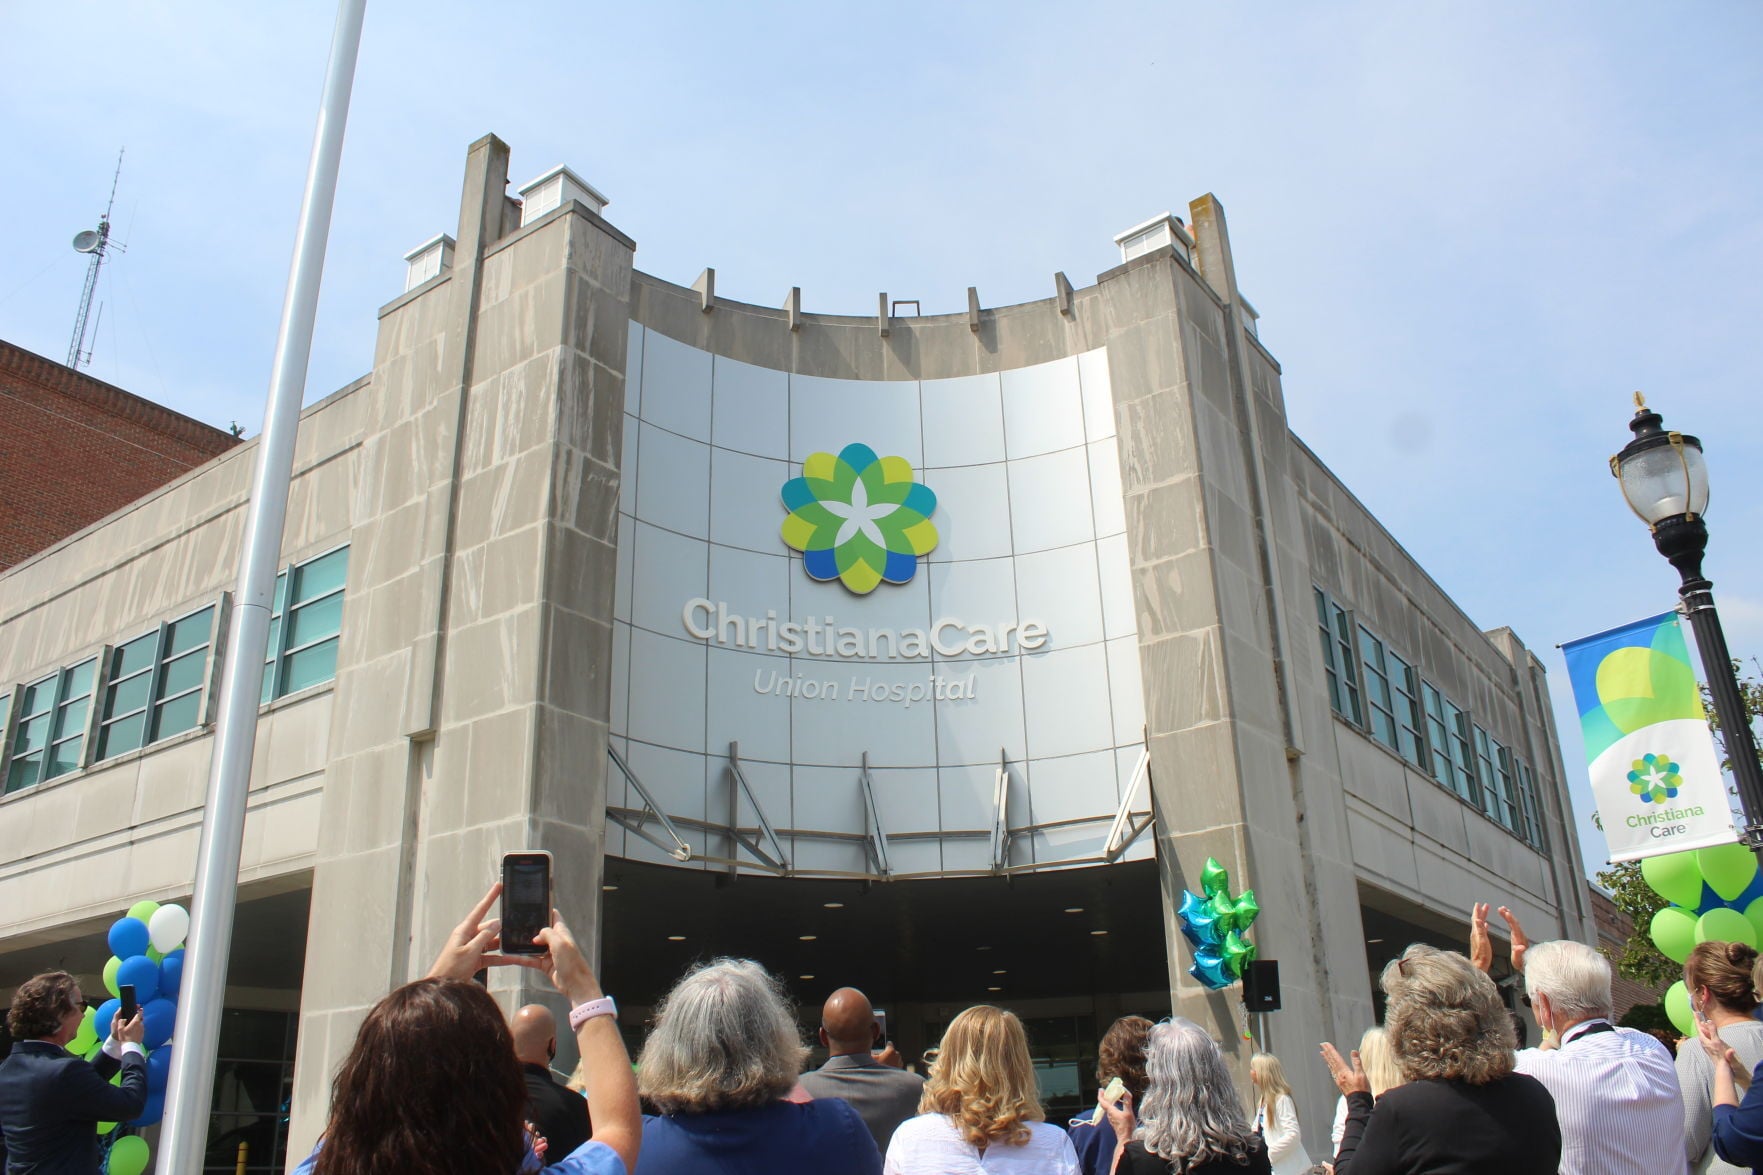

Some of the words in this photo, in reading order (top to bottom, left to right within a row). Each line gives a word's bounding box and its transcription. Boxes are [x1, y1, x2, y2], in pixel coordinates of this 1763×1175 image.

[683, 597, 1048, 658] ChristianaCare
[754, 668, 839, 700] Union
[847, 672, 976, 709] Hospital
[1626, 805, 1705, 828] Christiana
[1650, 824, 1687, 839] Care
